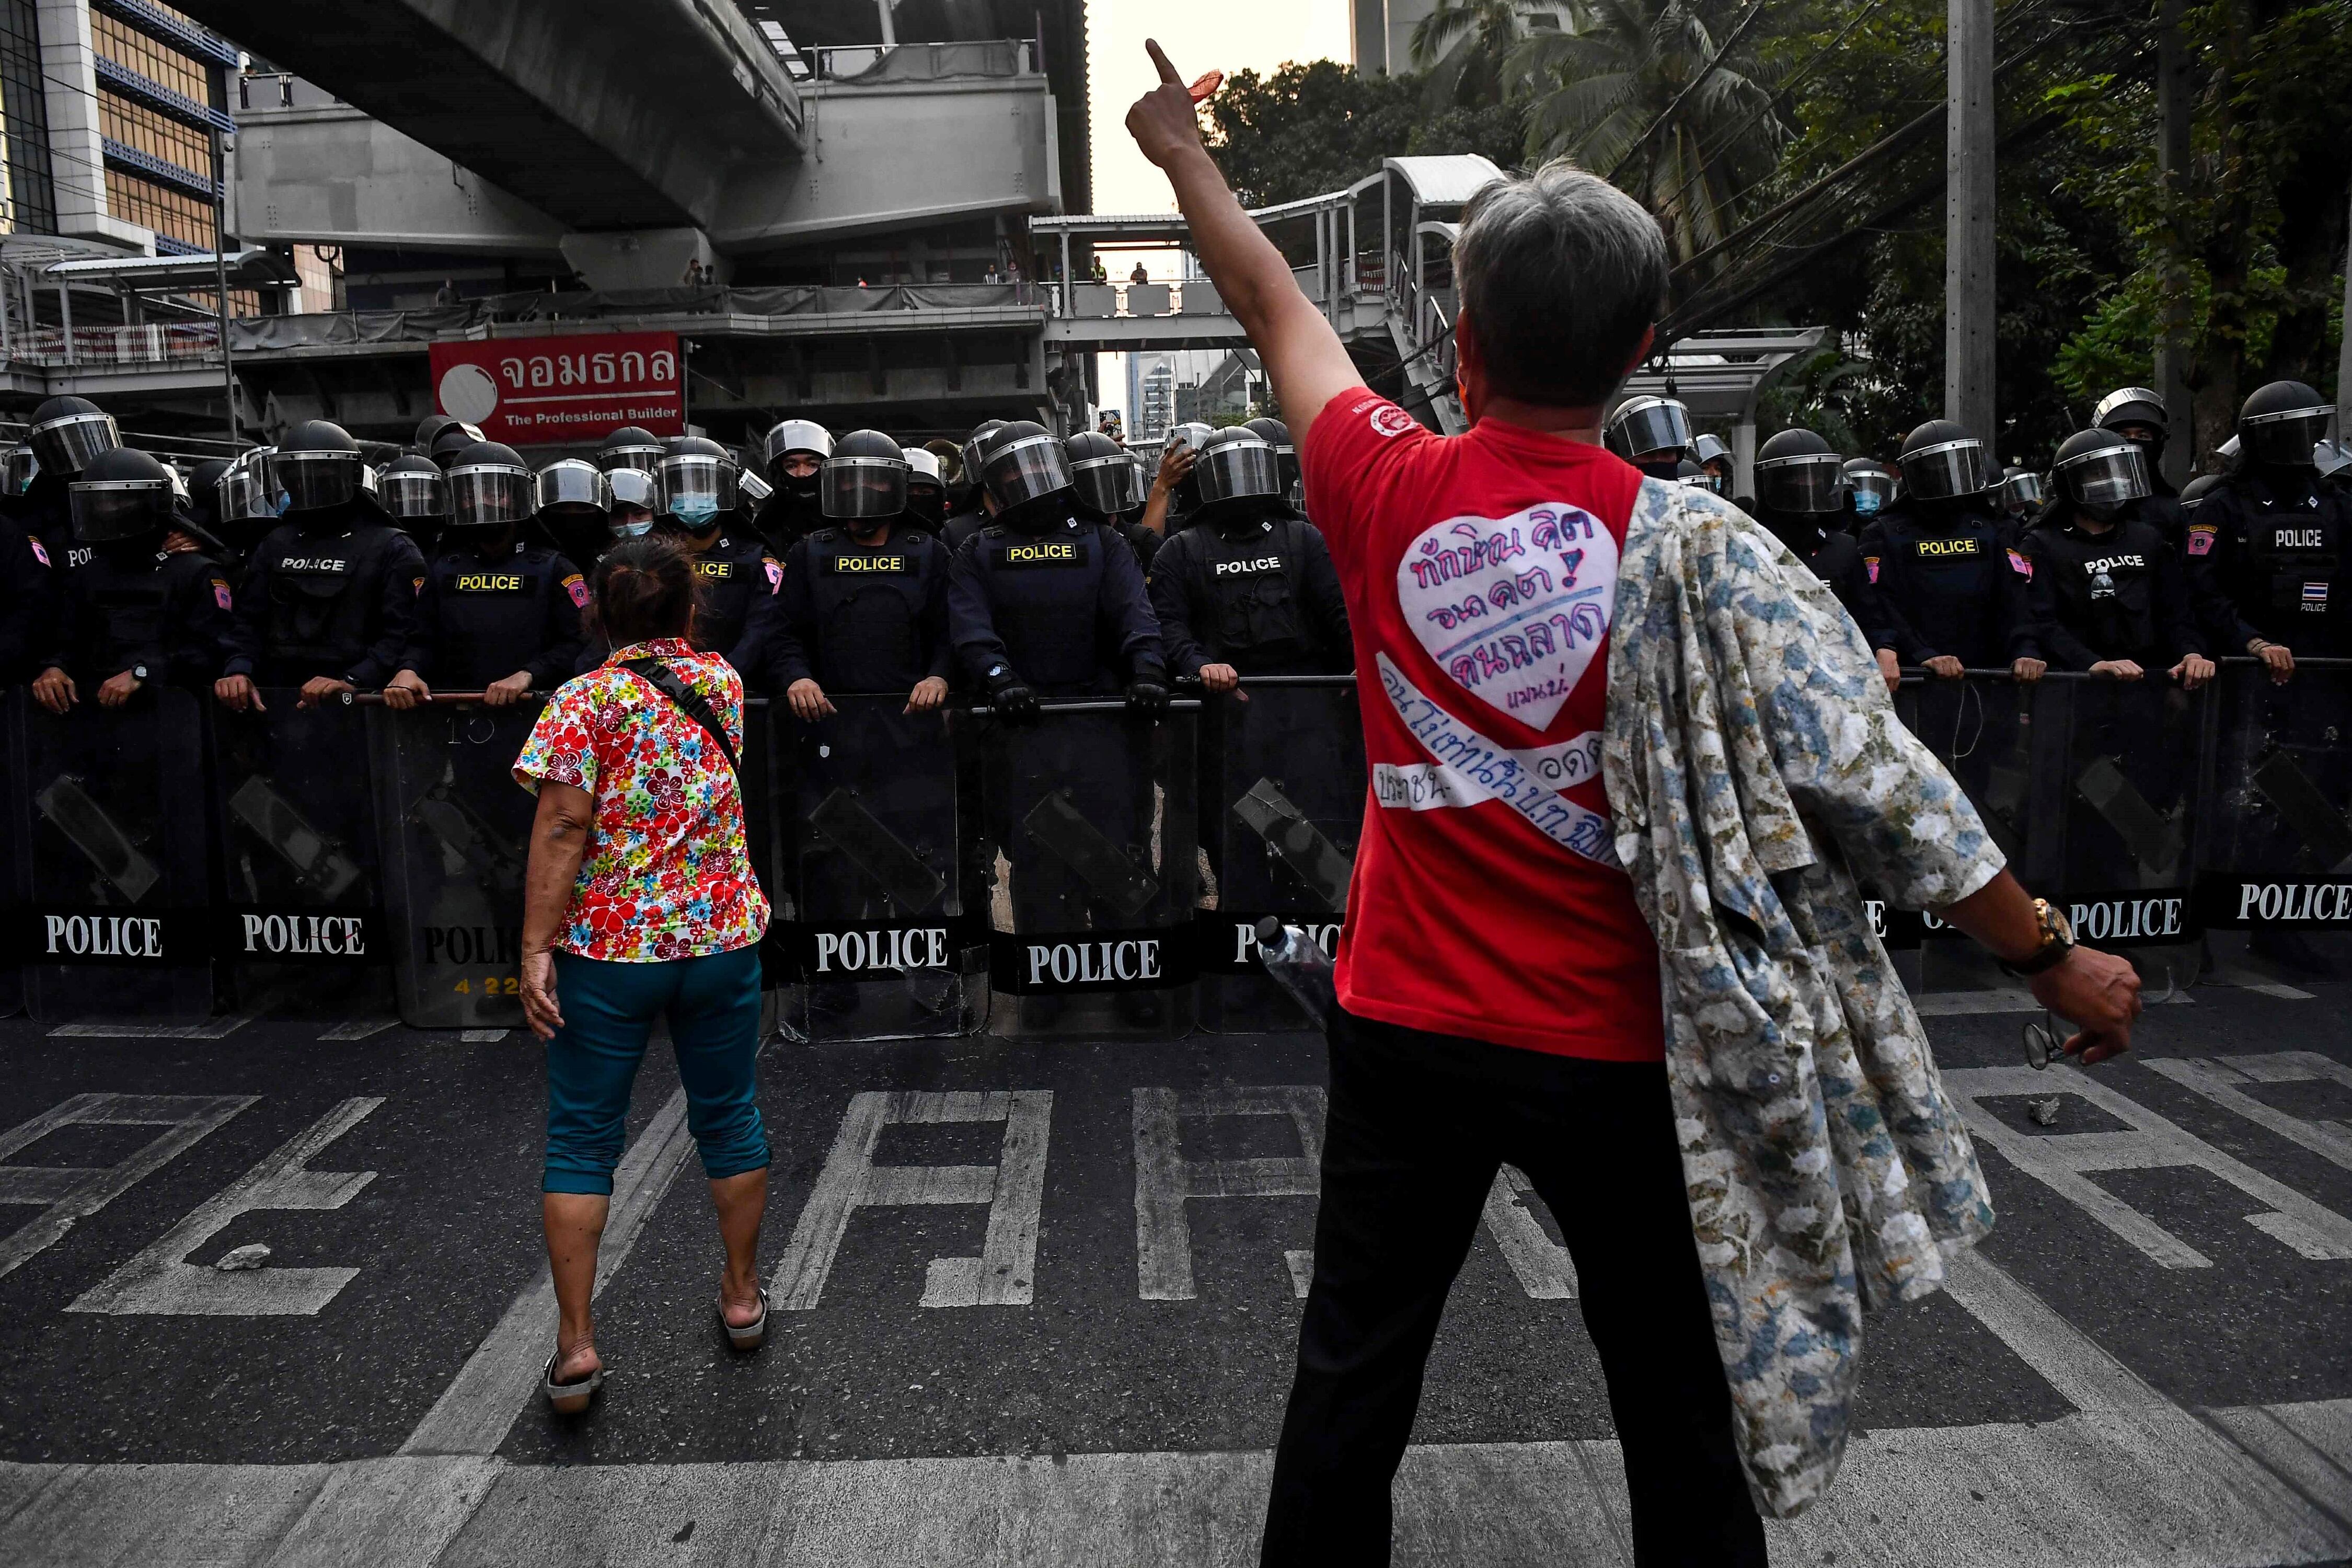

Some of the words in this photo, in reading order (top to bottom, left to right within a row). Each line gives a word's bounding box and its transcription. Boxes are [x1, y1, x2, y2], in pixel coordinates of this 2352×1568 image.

[500, 350, 675, 389] จอมธกล
[505, 415, 531, 425] The
[536, 409, 624, 423] Professional
[628, 407, 677, 419] Builder
[1919, 540, 1976, 554] POLICE
[2276, 529, 2322, 547] POLICE
[1009, 545, 1073, 560] POLICE
[1411, 523, 1525, 589] ทักษิณ
[838, 558, 901, 570] POLICE
[1216, 557, 1281, 575] POLICE
[2084, 555, 2145, 574] POLICE
[459, 575, 521, 590] POLICE
[2301, 603, 2327, 612] POLICE
[2236, 884, 2352, 920] POLICE
[2070, 898, 2182, 940] POLICE
[45, 915, 162, 957] POLICE
[241, 915, 365, 954] POLICE
[815, 928, 949, 972] POLICE
[1027, 940, 1161, 984] POLICE
